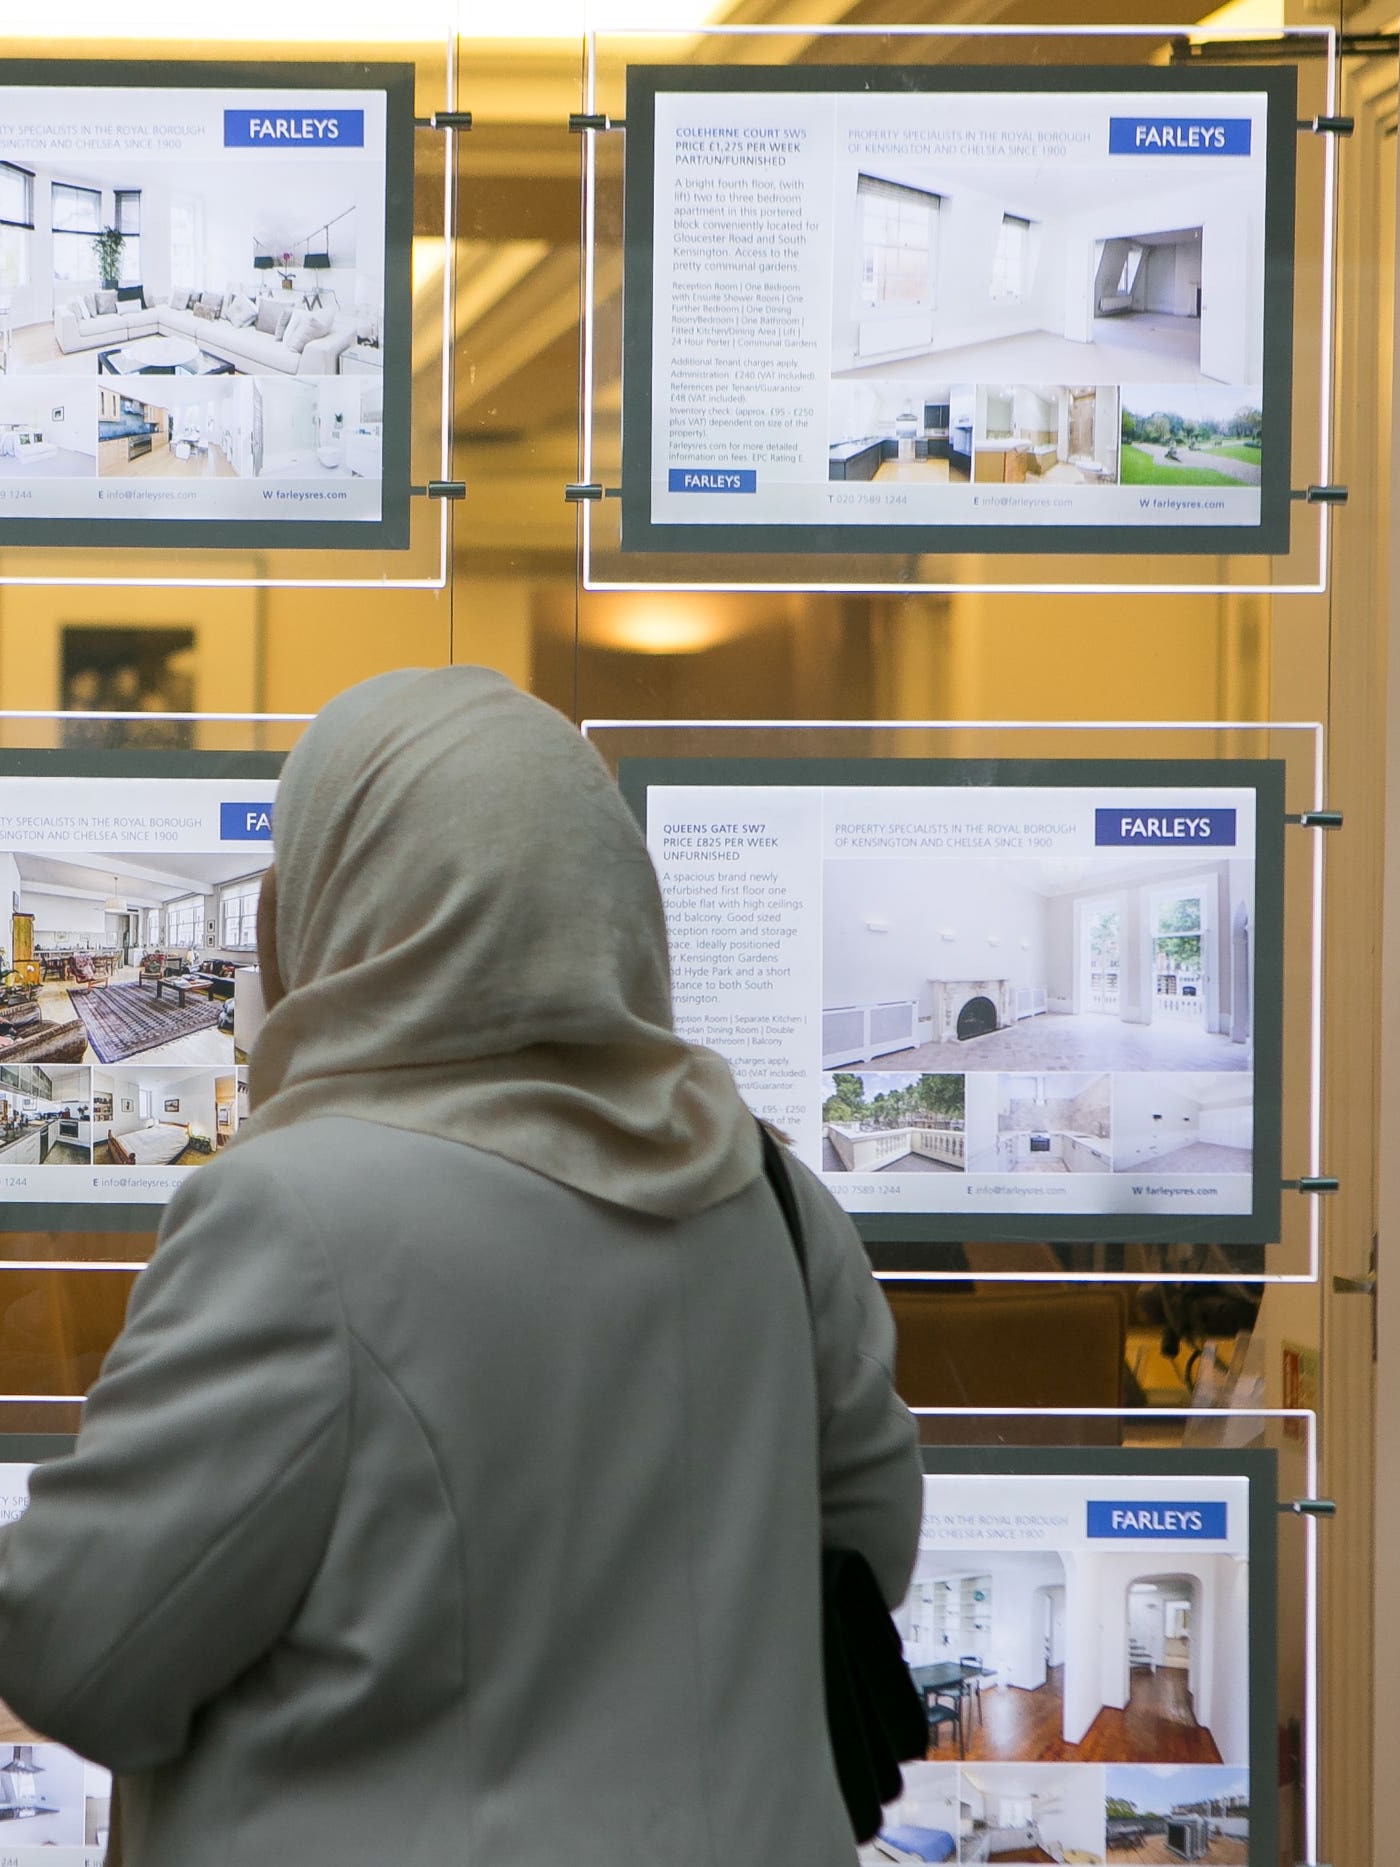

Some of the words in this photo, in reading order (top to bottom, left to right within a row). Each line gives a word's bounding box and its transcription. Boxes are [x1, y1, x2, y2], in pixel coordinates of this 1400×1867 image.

[250, 119, 339, 139] FARLEYS
[676, 128, 739, 138] COLEHERNE
[743, 128, 779, 138] COURT
[784, 129, 806, 138] SW5
[1136, 126, 1225, 147] FARLEYS
[676, 141, 704, 151] PRICE
[709, 142, 743, 153] £1,275
[747, 142, 766, 152] PER
[769, 142, 800, 152] WEEK
[675, 154, 786, 166] PART/UN/FURNISHED
[685, 474, 740, 488] FARLEYS
[263, 490, 273, 499] W
[276, 490, 347, 501] farleysres.com
[1139, 499, 1150, 508] W
[1153, 498, 1224, 511] farleysres.com
[663, 824, 707, 835] QUEENS
[711, 824, 738, 833] GATE
[742, 824, 765, 833] SW7
[1121, 818, 1210, 837] FARLEYS
[663, 837, 692, 847] PRICE
[696, 837, 721, 847] £825
[725, 837, 744, 847] PER
[746, 837, 778, 847] WEEK
[663, 851, 740, 861] UNFURNISHED
[663, 872, 671, 881] A
[673, 874, 715, 883] spacious
[718, 872, 746, 882] brand
[750, 872, 778, 884] newly
[1131, 1186, 1144, 1195] W
[1145, 1186, 1218, 1197] farleysres.com
[1112, 1510, 1202, 1530] FARLEYS
